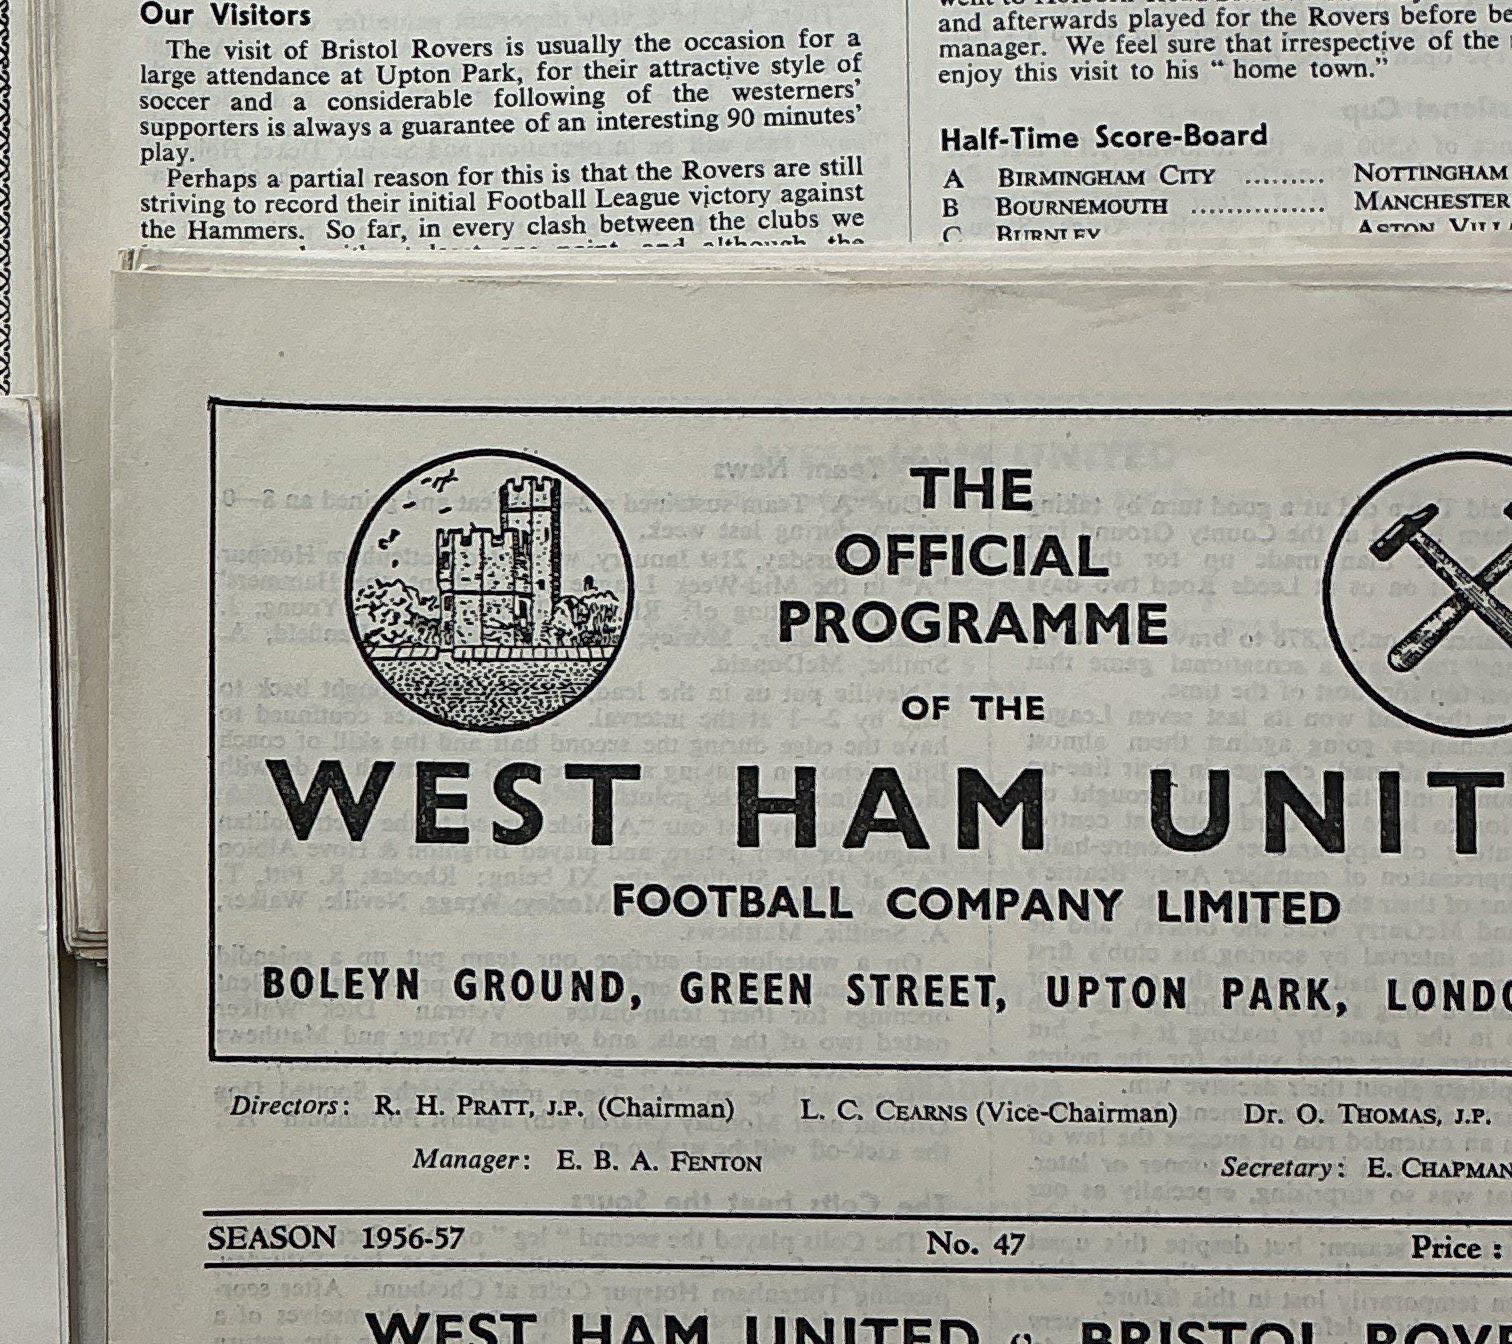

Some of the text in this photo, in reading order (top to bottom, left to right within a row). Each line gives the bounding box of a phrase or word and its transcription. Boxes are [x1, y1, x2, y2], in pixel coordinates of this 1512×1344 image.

[139, 0, 312, 27] Our Visitors
[908, 466, 1034, 513] THE
[834, 531, 1110, 579] OFFICIAL
[779, 599, 1169, 646] PROGRAMME
[901, 694, 1045, 721] OF THE
[263, 758, 642, 847] WEST
[736, 764, 1045, 851] HAM
[612, 882, 1341, 926] FOOTBALL COMPANY LIMITED
